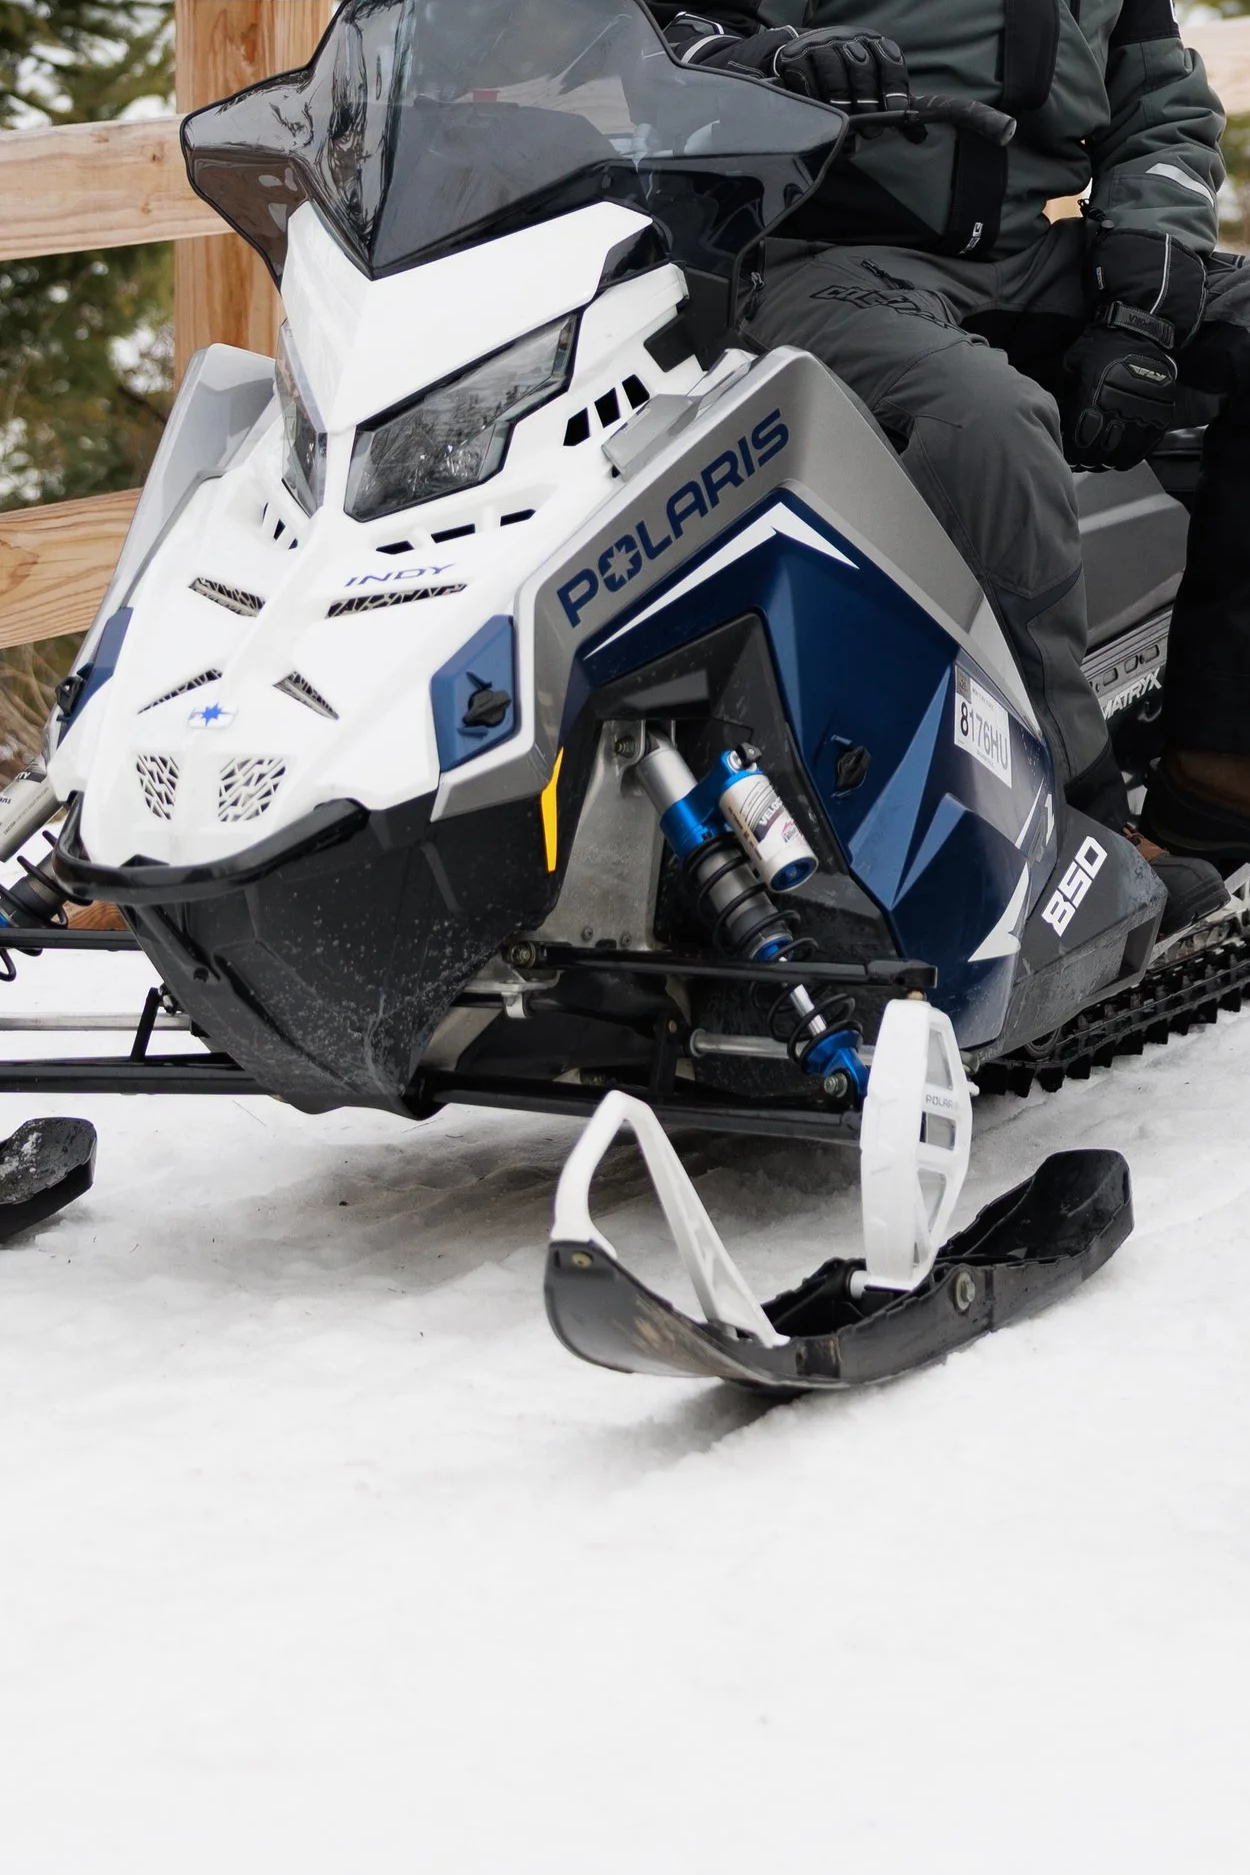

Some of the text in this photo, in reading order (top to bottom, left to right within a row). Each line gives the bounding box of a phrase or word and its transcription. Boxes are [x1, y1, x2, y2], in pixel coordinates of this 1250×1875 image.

[556, 407, 790, 629] POLARIS
[344, 563, 456, 587] INDY
[960, 701, 1009, 771] 8176HU
[1041, 835, 1108, 938] 850
